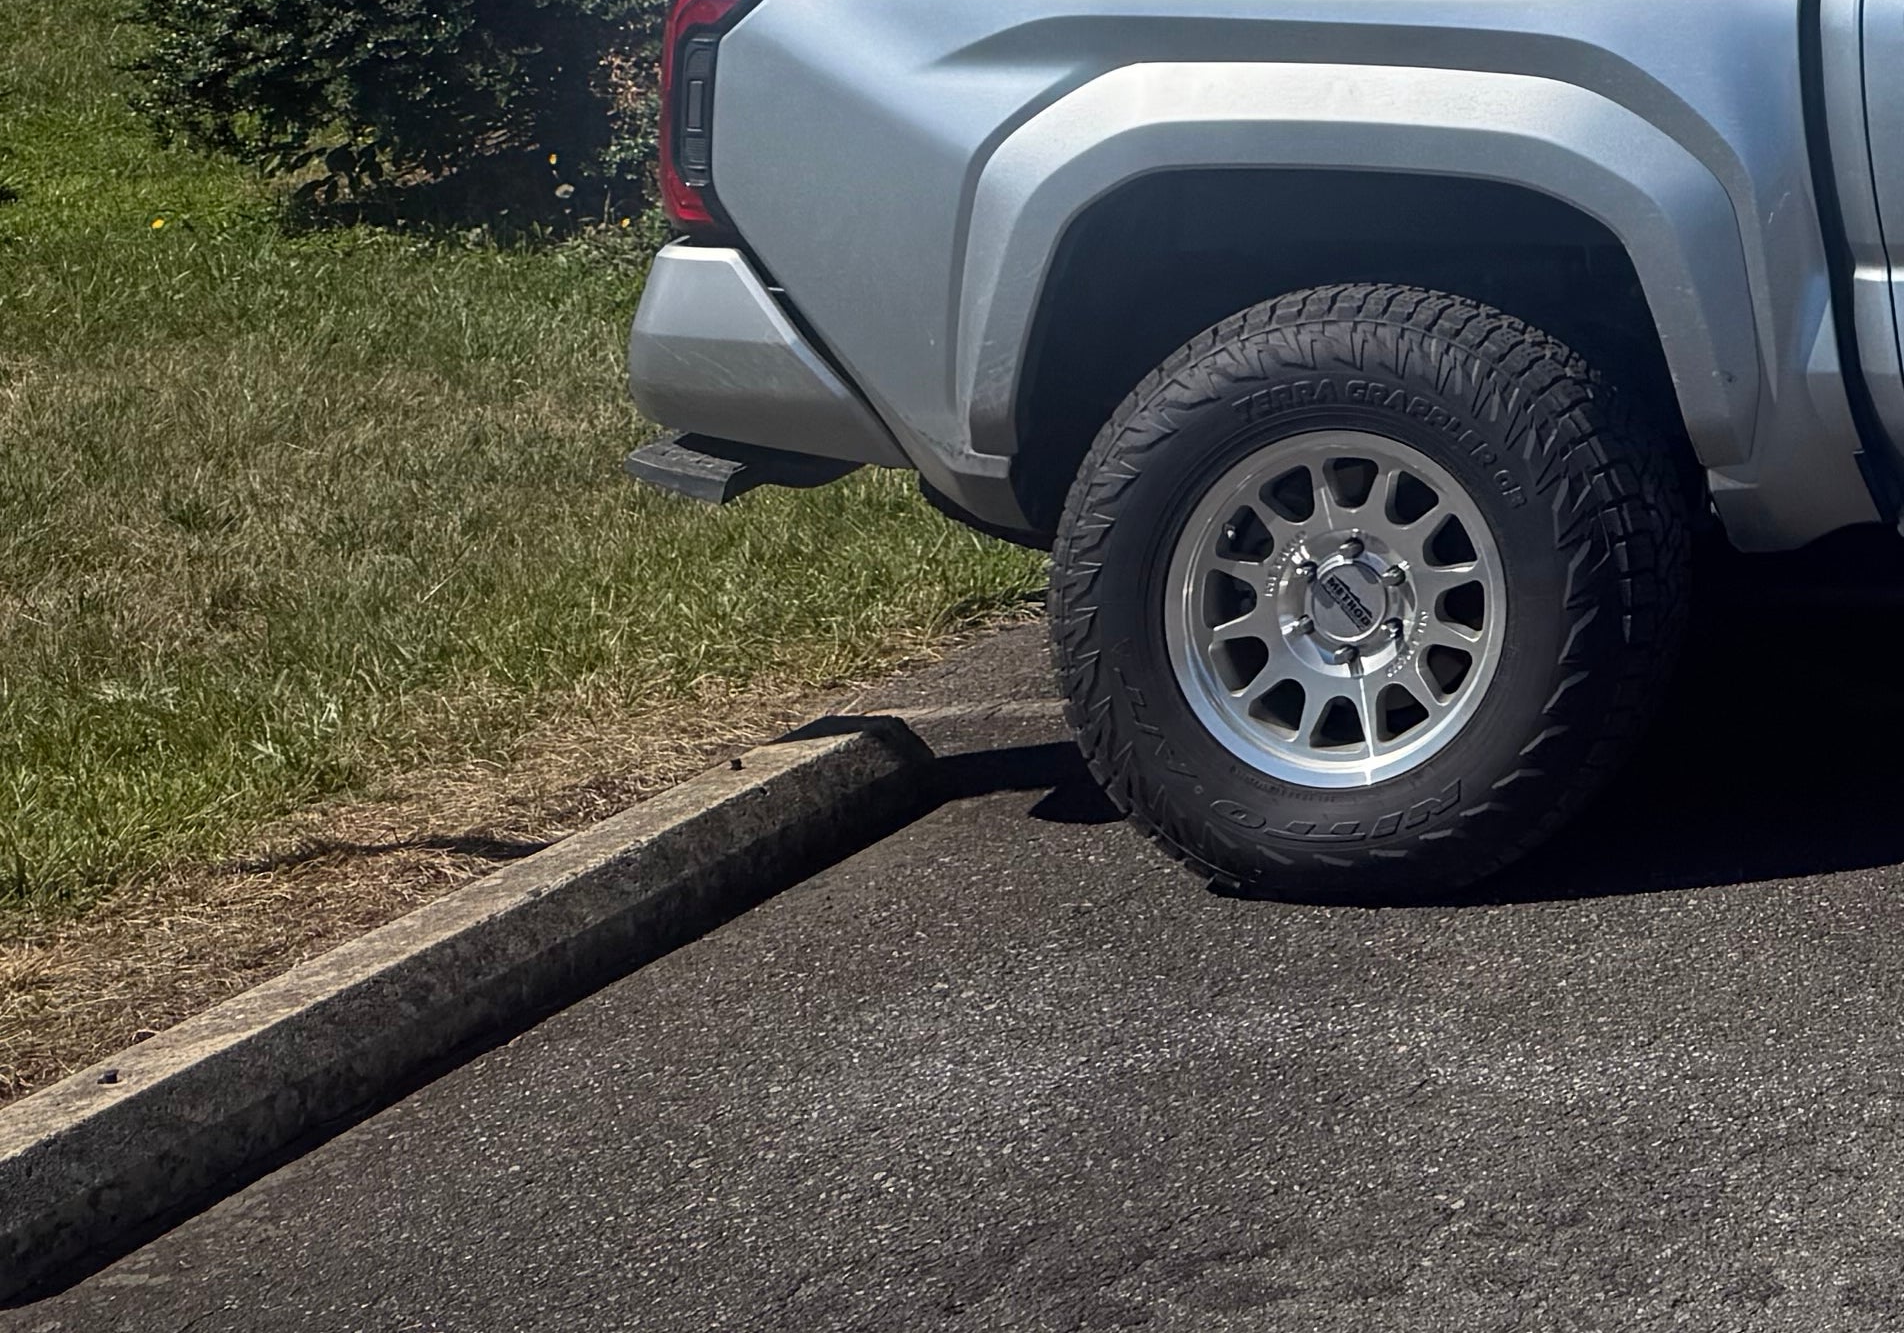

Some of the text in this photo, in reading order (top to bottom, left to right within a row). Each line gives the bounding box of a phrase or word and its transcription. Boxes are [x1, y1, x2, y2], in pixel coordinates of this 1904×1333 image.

[1231, 378, 1338, 421] TERRA
[1344, 379, 1498, 466] GRAPPLER
[1327, 577, 1371, 626] METHOD
